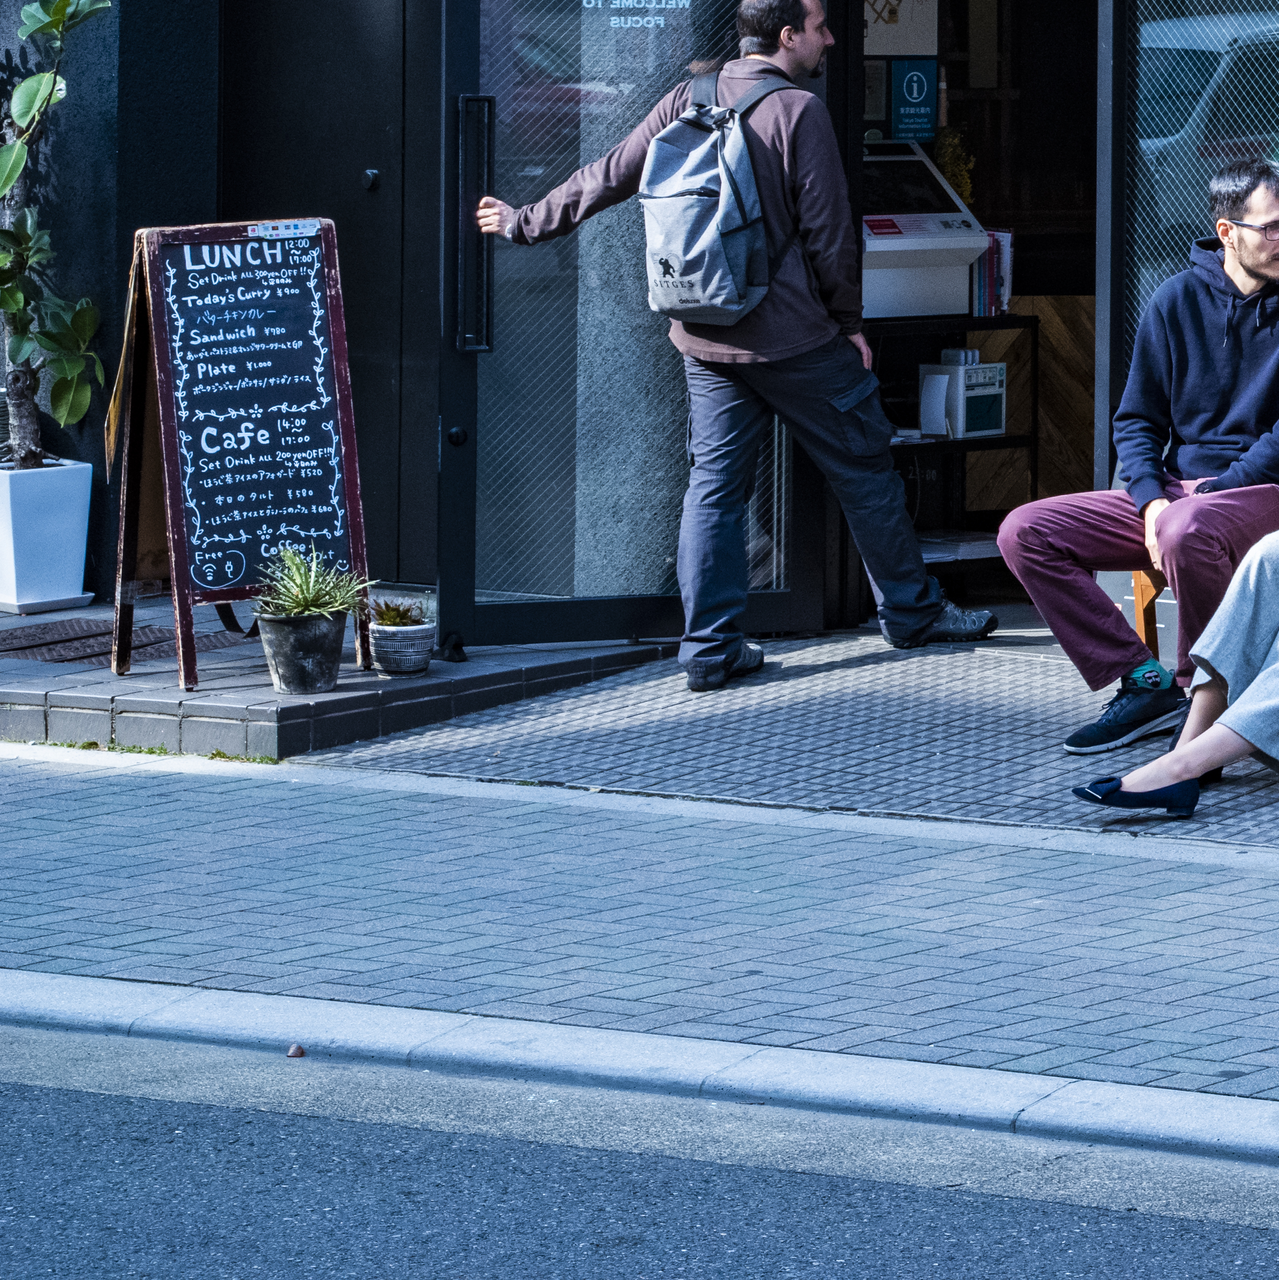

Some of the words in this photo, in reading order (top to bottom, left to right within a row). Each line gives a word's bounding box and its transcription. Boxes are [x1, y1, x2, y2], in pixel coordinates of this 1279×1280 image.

[183, 241, 283, 270] LUNCH
[285, 238, 310, 250] 12:00
[289, 255, 312, 265] 17:00
[187, 273, 210, 289] Set
[211, 271, 238, 285] Drink
[653, 279, 695, 289] SITGES
[181, 289, 235, 308] Today's
[237, 286, 271, 301] Curry
[276, 288, 300, 297] ¥900
[196, 308, 277, 326] バターチキンカレー
[189, 324, 256, 345] Sandwich
[264, 327, 286, 336] ¥780
[197, 363, 236, 379] Plate
[200, 422, 271, 454] Cafe
[277, 418, 307, 432] 14:00
[281, 435, 310, 446] 17:00
[199, 458, 221, 473] Set
[225, 454, 256, 467] Drink
[300, 468, 323, 478] ¥520
[287, 488, 314, 499] ¥580
[311, 504, 333, 514] ¥680
[195, 552, 223, 565] Free
